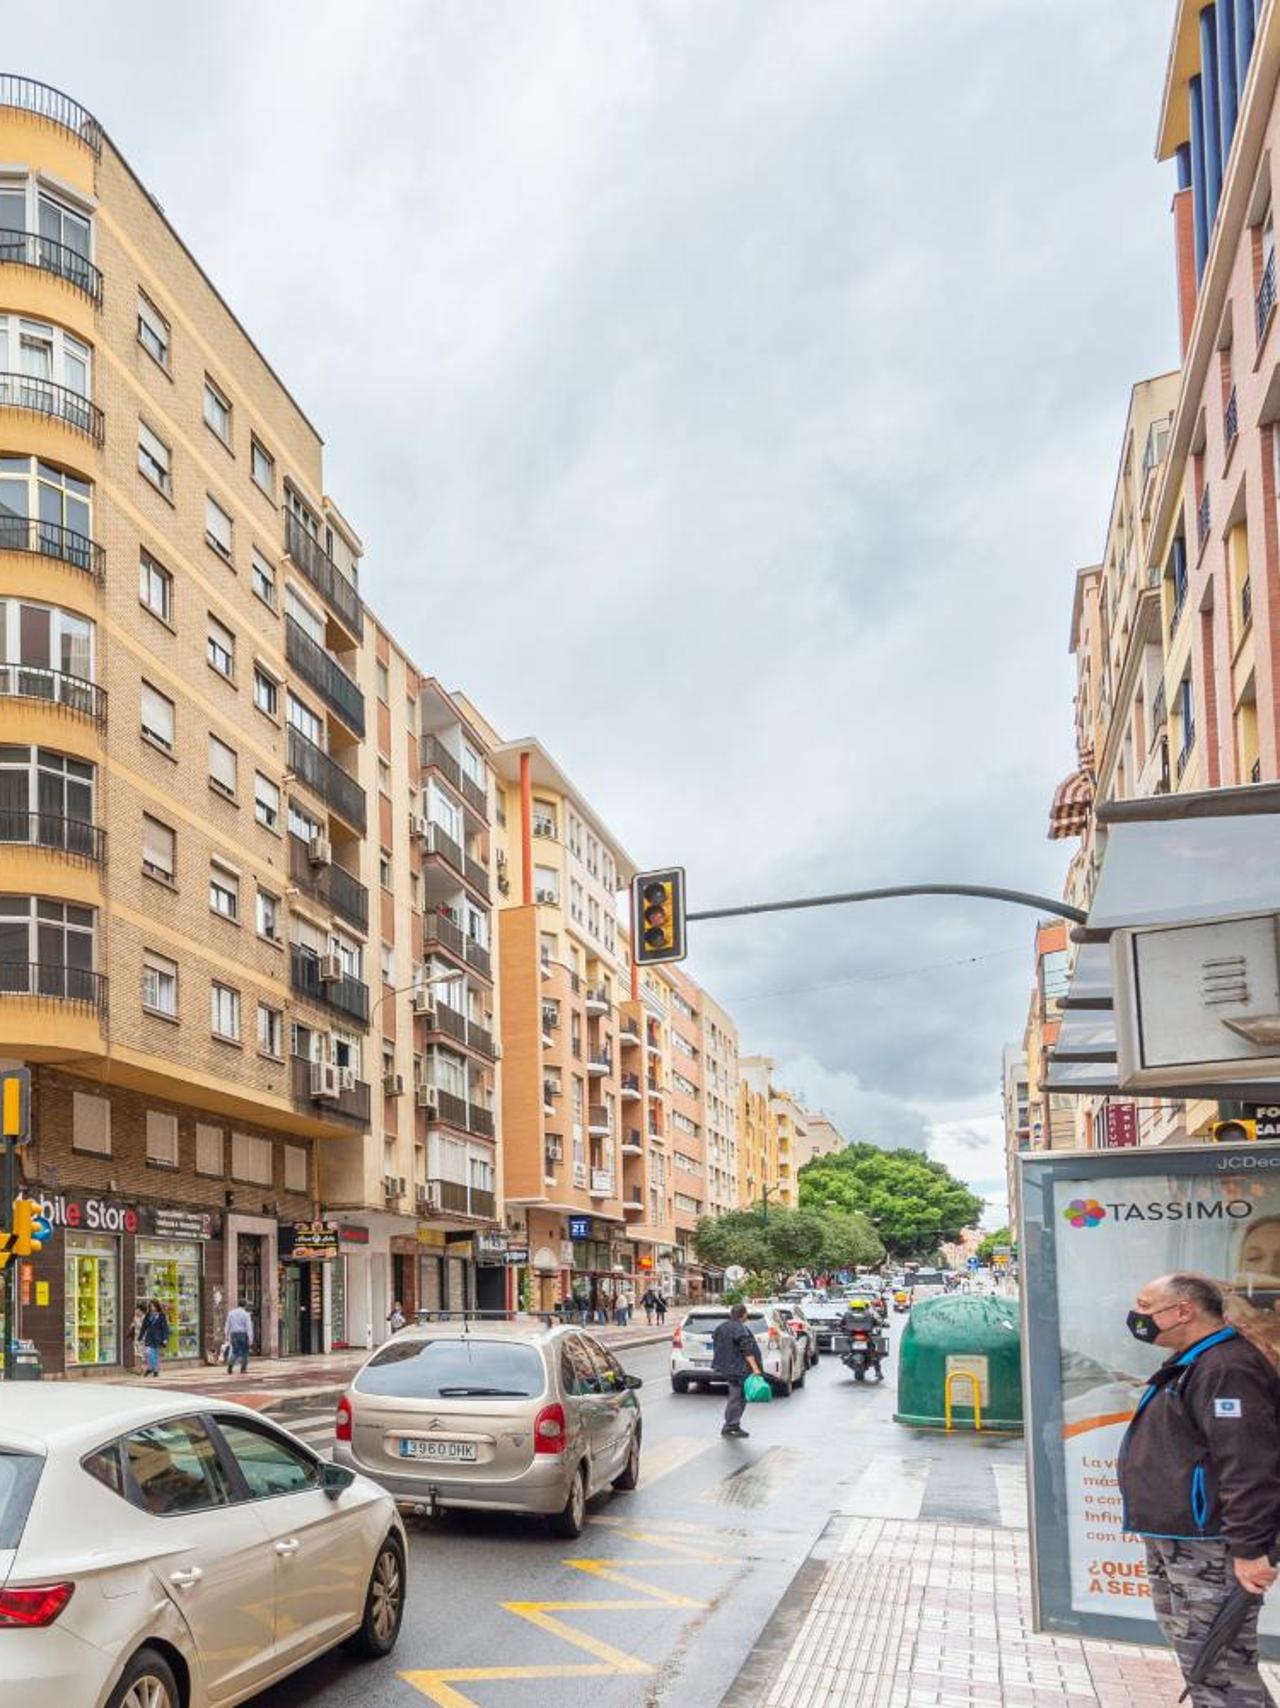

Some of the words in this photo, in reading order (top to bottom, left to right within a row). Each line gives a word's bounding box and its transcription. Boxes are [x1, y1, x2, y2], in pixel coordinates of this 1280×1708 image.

[86, 1199, 138, 1233] Store
[1105, 1200, 1253, 1221] TASSIMO
[411, 1441, 446, 1455] 3960
[449, 1442, 473, 1457] DHK
[1082, 1456, 1101, 1468] La
[1086, 1531, 1116, 1541] con
[1089, 1560, 1147, 1579] ¿QUÉ
[1090, 1579, 1103, 1593] A
[1107, 1581, 1152, 1597] SER
